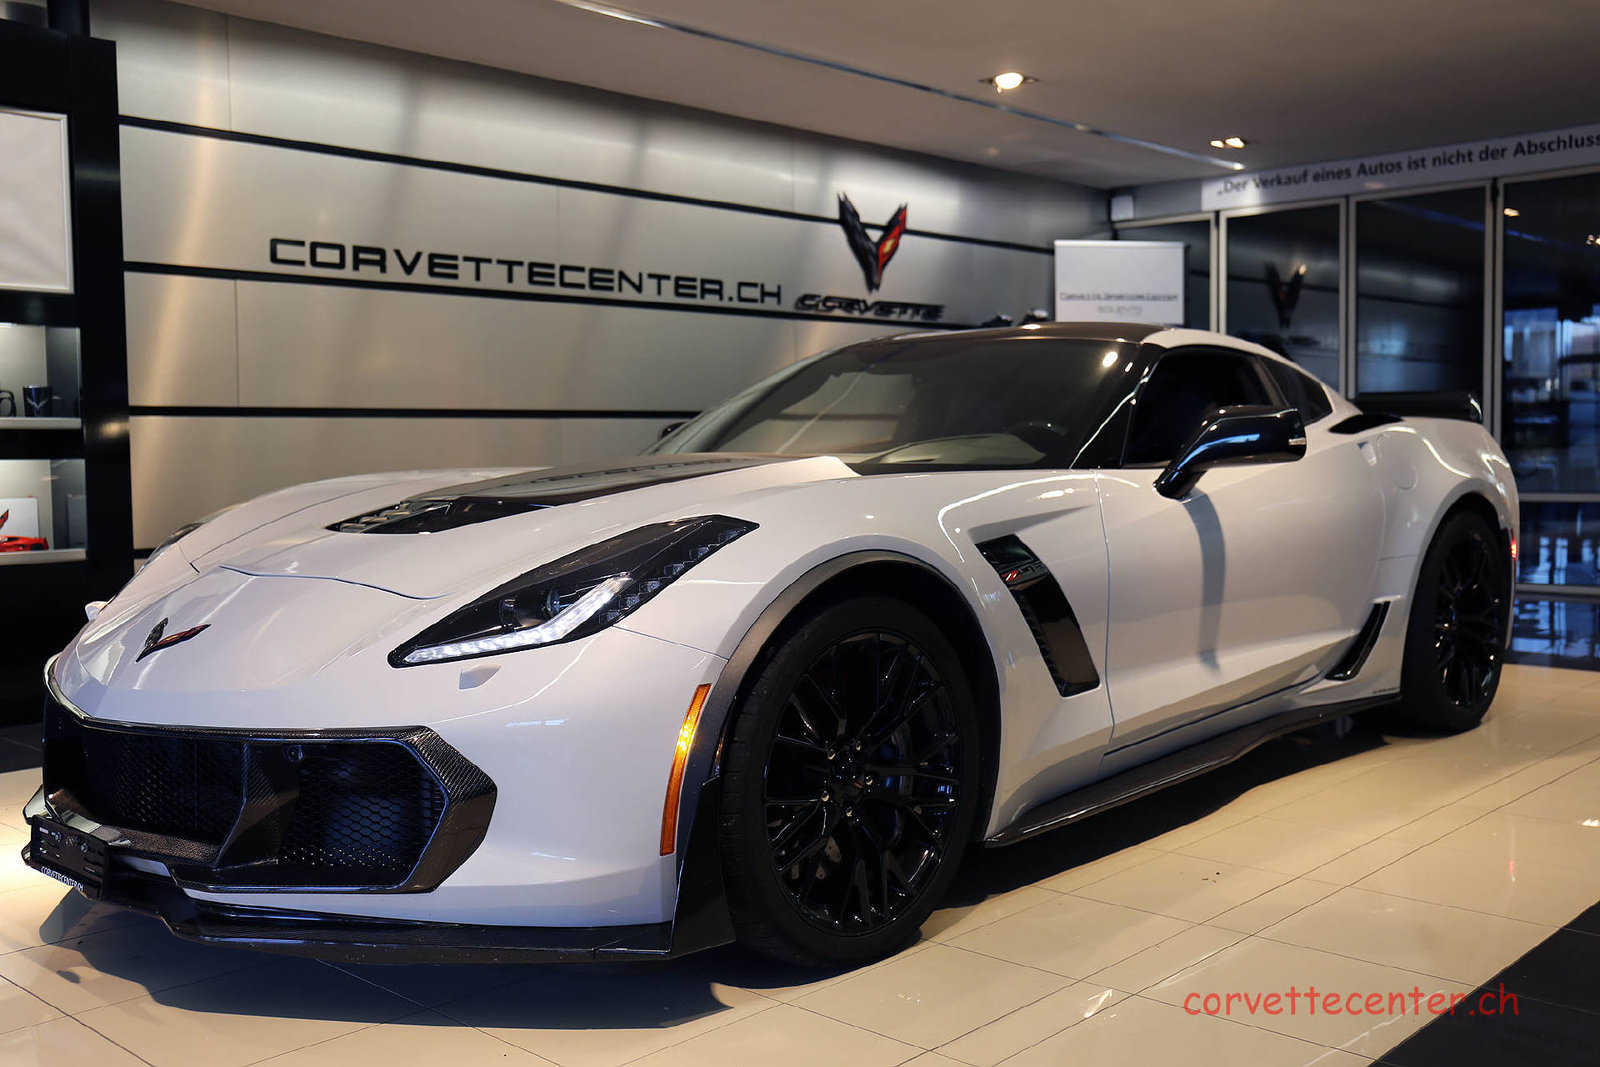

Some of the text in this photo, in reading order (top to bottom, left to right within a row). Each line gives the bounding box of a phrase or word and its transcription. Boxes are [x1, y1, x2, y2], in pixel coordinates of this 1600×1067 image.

[1253, 170, 1309, 189] Verkauf
[1313, 167, 1352, 182] eines
[1357, 160, 1403, 177] Autos
[1407, 156, 1426, 171] ist
[1432, 151, 1474, 167] nicht
[1479, 145, 1508, 162] der
[270, 239, 782, 305] CORVETTECENTER.CH
[795, 293, 944, 321] CORVETTE
